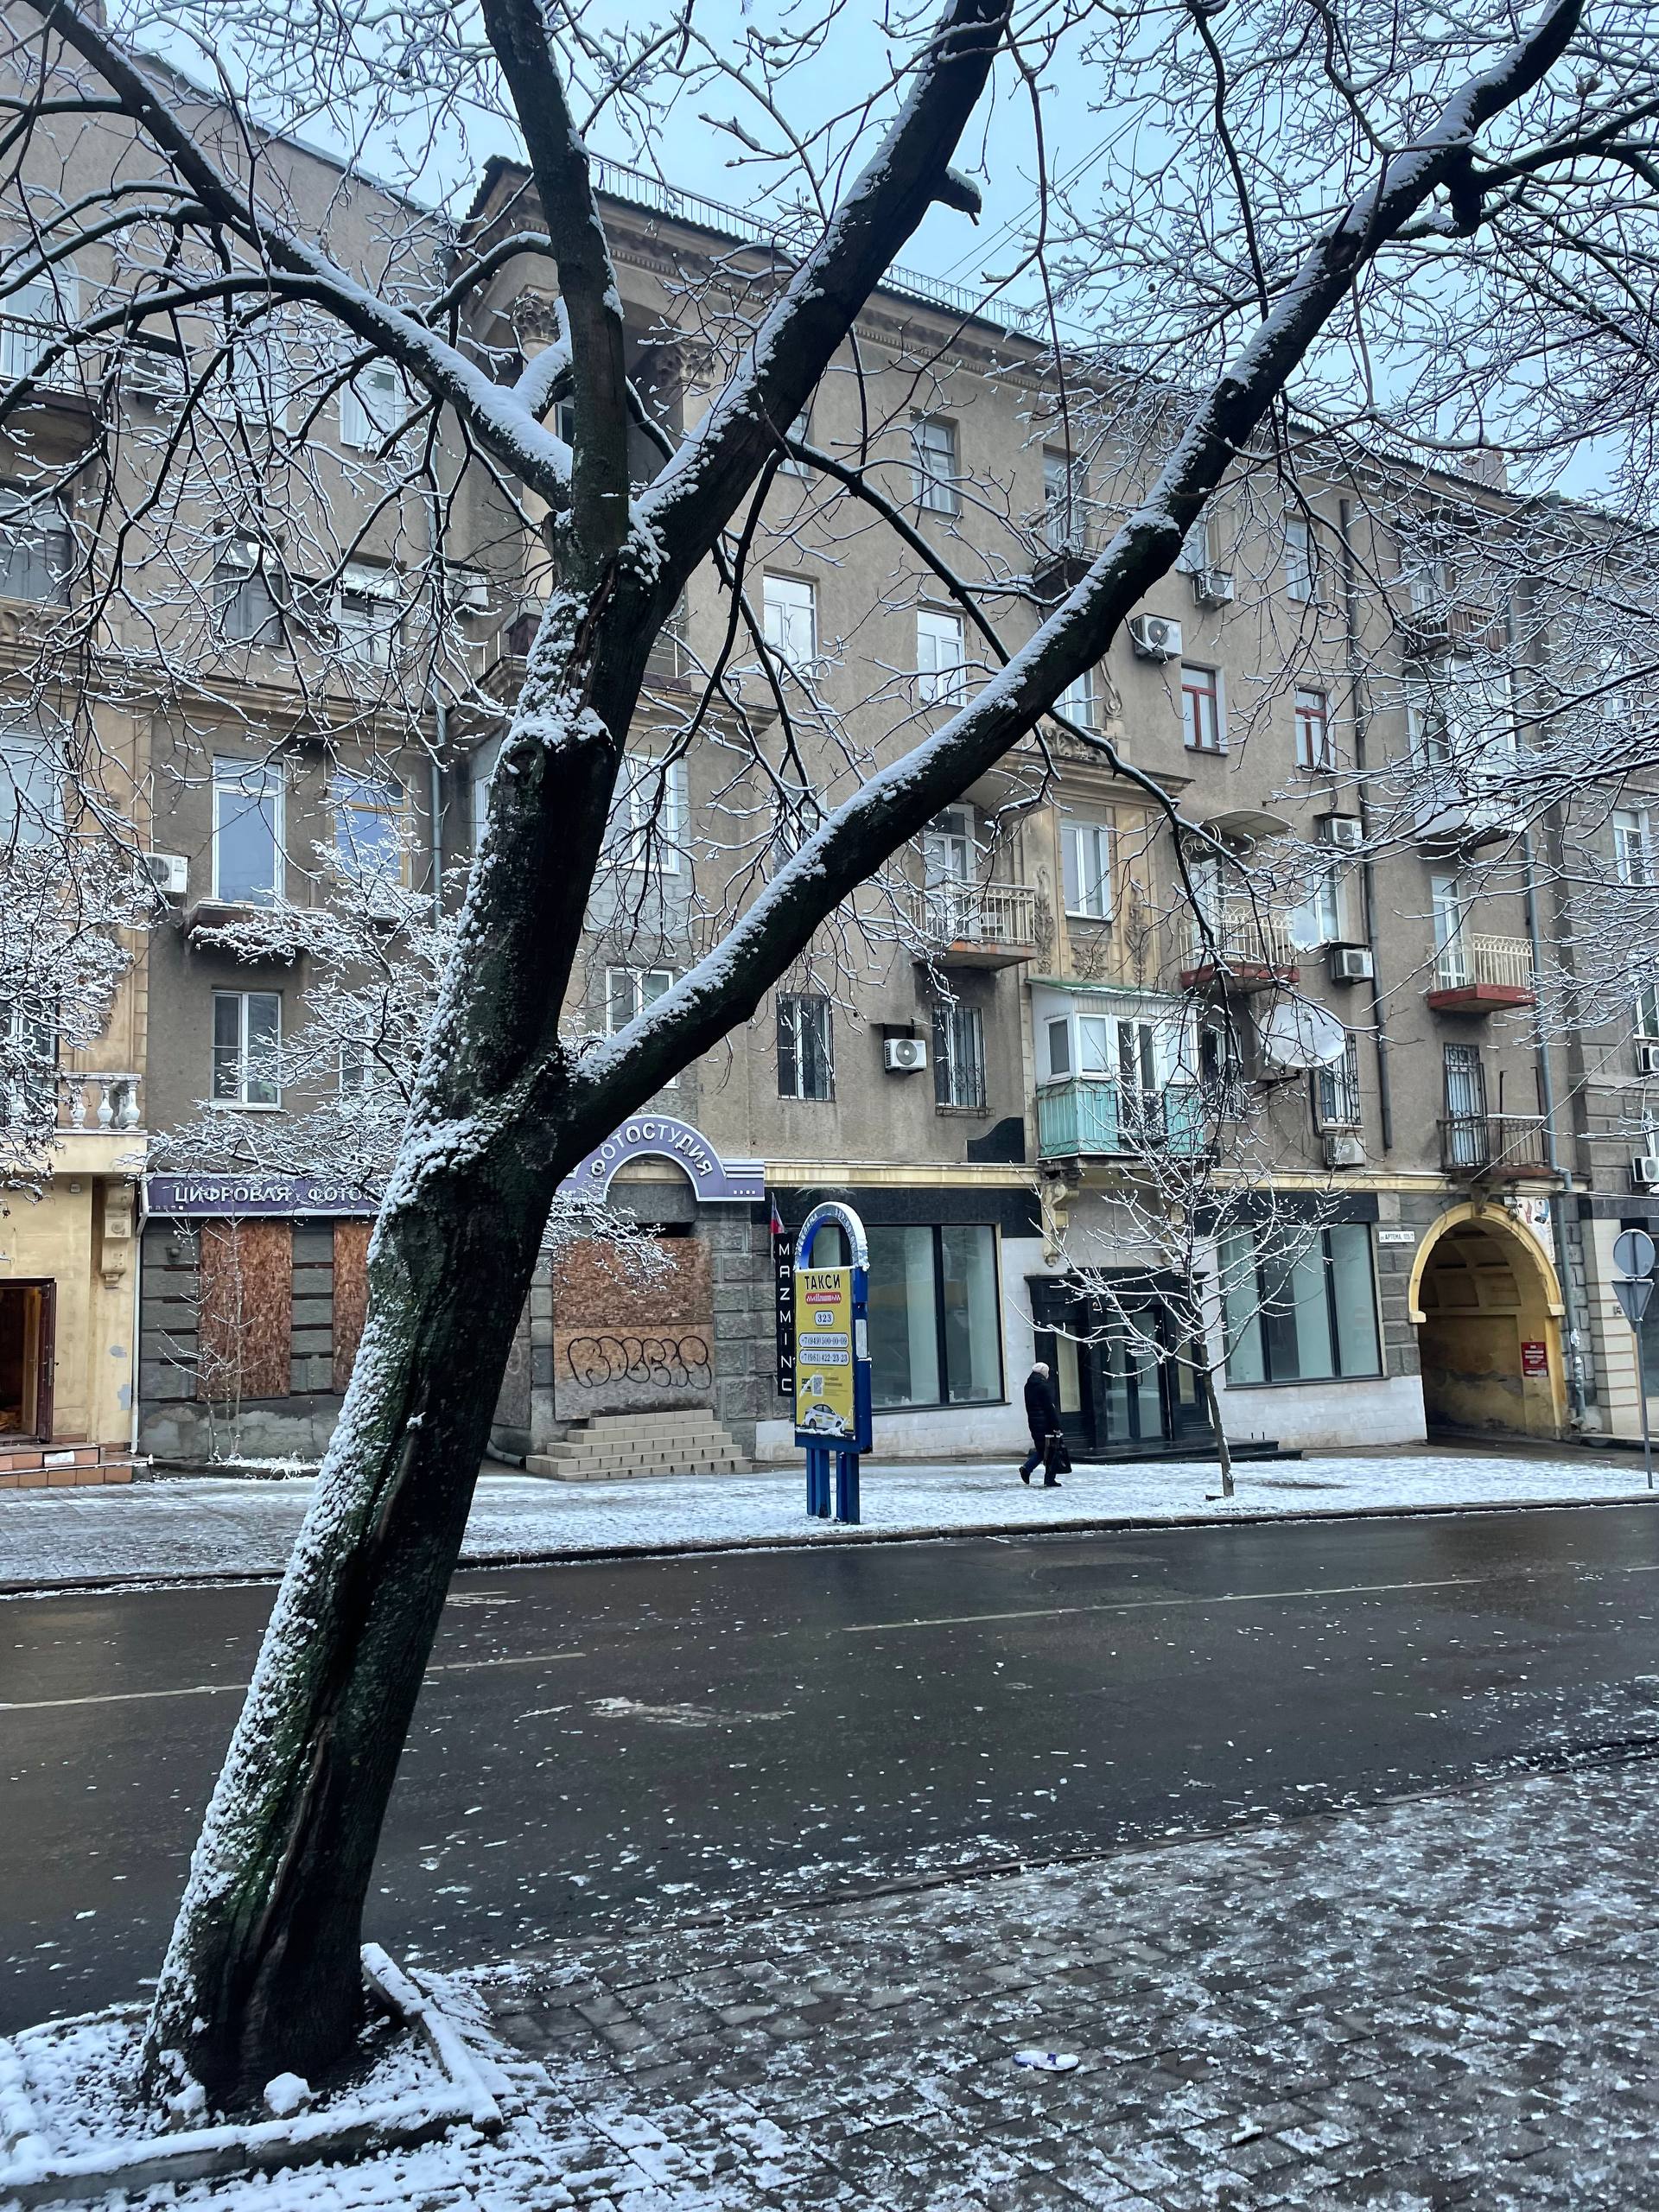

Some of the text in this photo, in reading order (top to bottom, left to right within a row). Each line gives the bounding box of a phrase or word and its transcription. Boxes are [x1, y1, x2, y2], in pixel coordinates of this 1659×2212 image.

[591, 1122, 713, 1177] ФОТОСТУДИЯ
[175, 1185, 291, 1204] ЦИФРОВАЯ
[804, 1274, 841, 1290] ТАКСИ
[817, 1313, 832, 1323] 323
